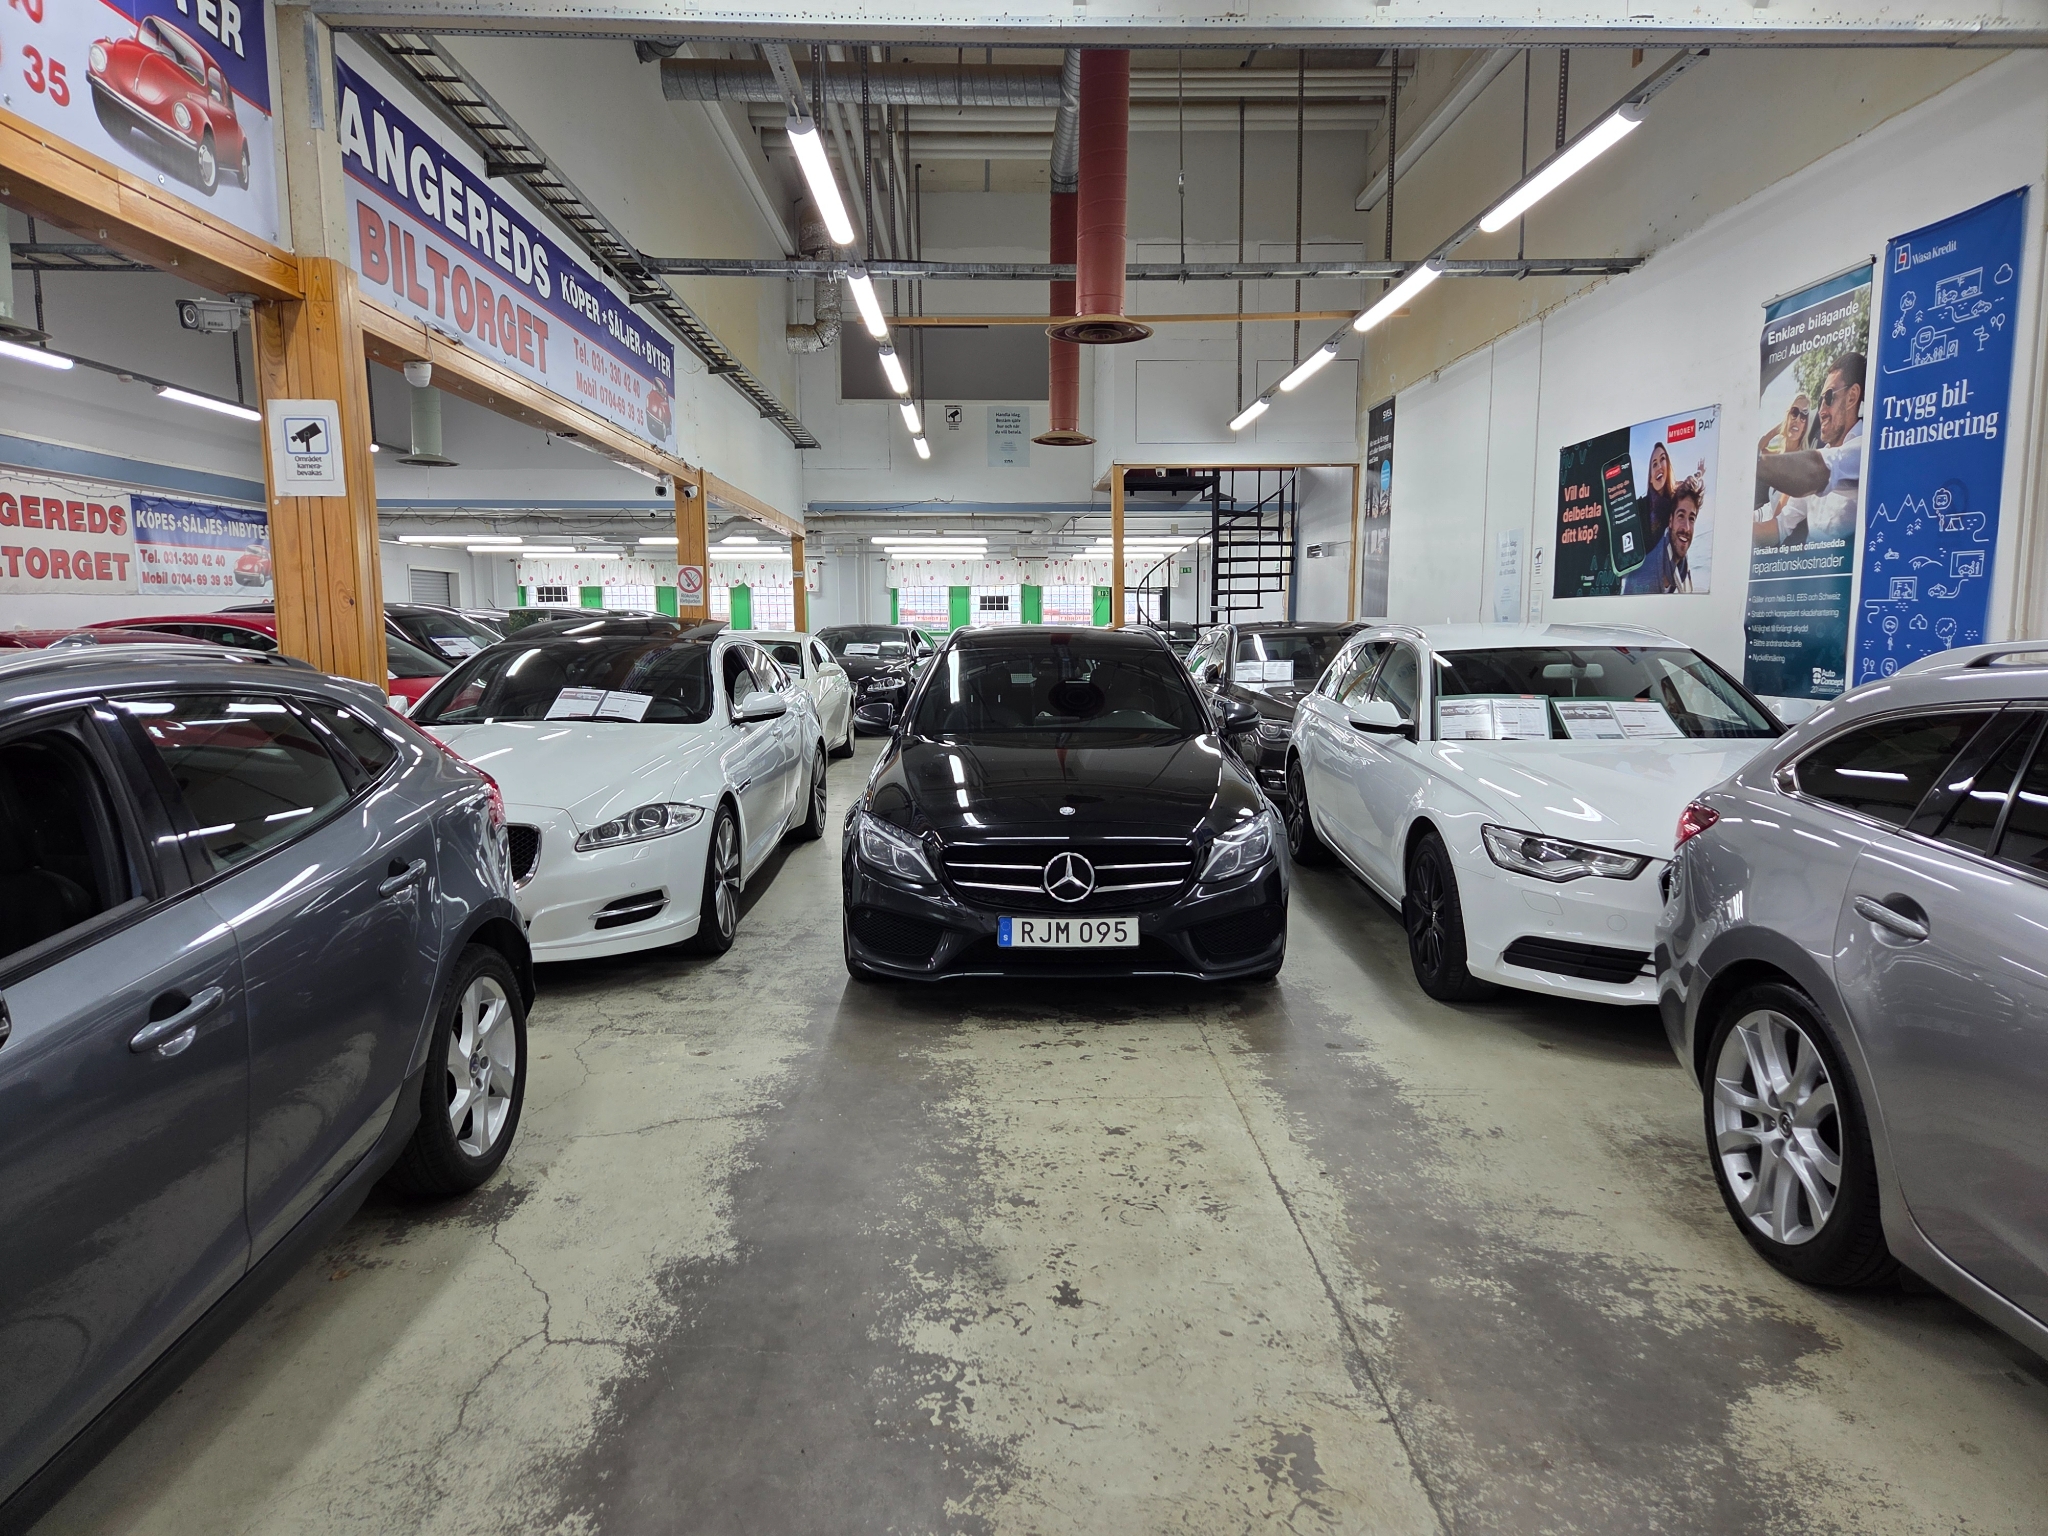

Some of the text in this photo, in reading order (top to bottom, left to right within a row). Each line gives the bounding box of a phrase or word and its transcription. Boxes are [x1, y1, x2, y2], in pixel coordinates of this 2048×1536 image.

[176, 0, 245, 58] ER
[22, 44, 71, 107] 35
[341, 86, 551, 300] ANGEREDS
[1912, 240, 1957, 265] Wasa Kredit
[356, 199, 549, 374] BILTORGET
[560, 271, 671, 378] KÖPER SÄLJER BYTER
[1767, 300, 1859, 345] Enklare bilägande
[1768, 321, 1856, 364] med AutoConcept
[573, 337, 589, 366] Tel.
[609, 361, 622, 387] 330
[623, 371, 632, 393] 42
[633, 378, 641, 399] 40
[575, 370, 598, 400] Mobil
[627, 401, 635, 421] 39
[636, 408, 644, 427] 35
[1883, 378, 1975, 423] Trygg bil-
[1698, 418, 1716, 432] PAY
[1879, 411, 1999, 451] finansiering
[1564, 485, 1578, 502] Vill
[1578, 483, 1590, 498] du
[136, 508, 176, 531] KÖPES
[182, 514, 223, 536] SÄLJES
[1563, 502, 1602, 523] delbetala
[1561, 524, 1599, 544] ditt köp?
[1753, 538, 1846, 556] Försäkra dig mot oförutsedda
[0, 545, 130, 581] TORGET
[140, 549, 161, 564] Tel.
[201, 553, 213, 567] 42
[215, 554, 226, 567] 40
[1752, 553, 1845, 576] reparationskostnader
[142, 571, 168, 585] Mobil
[210, 574, 220, 586] 39
[223, 575, 234, 587] 35
[1796, 593, 1807, 601] EES
[1818, 592, 1841, 600] Schweiz
[1820, 677, 1844, 688] Concept
[1821, 669, 1836, 677] Auto
[1021, 921, 1070, 943] RJM
[1079, 921, 1128, 944] 095
